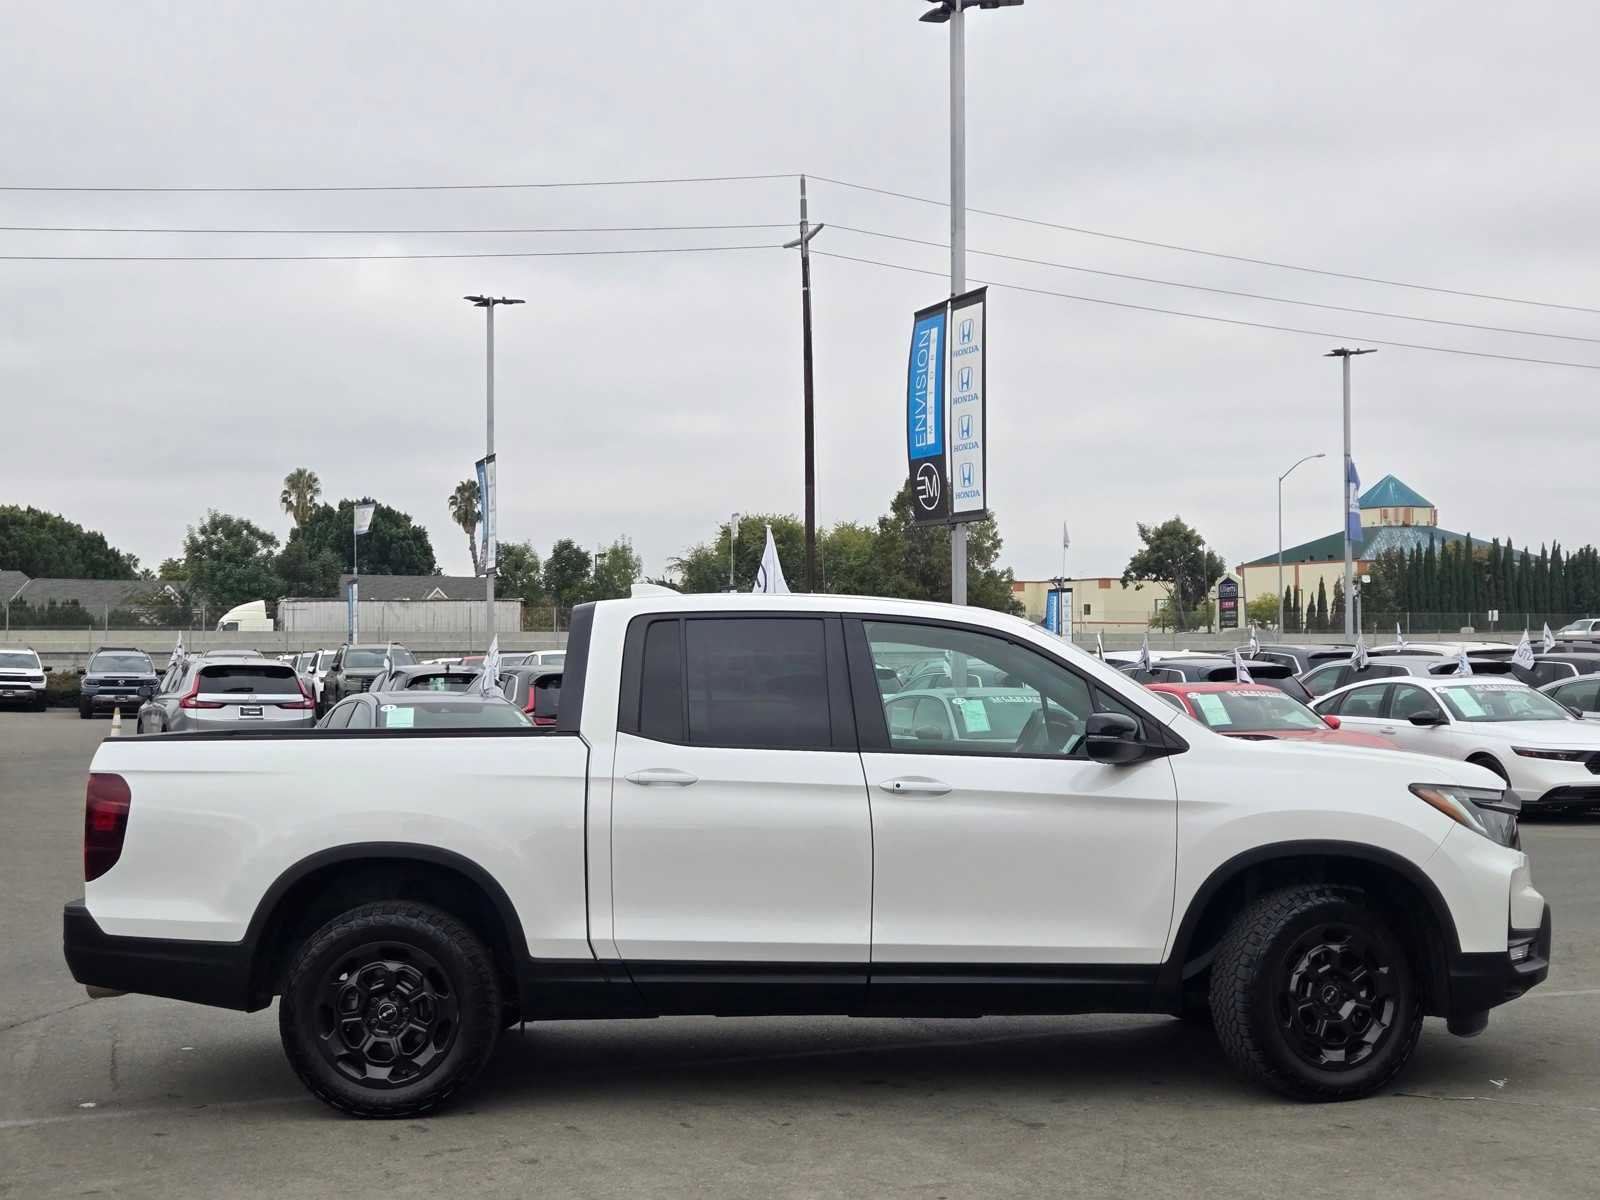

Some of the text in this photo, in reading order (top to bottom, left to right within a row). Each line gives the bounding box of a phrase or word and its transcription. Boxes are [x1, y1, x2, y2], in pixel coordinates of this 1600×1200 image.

[953, 345, 980, 358] HONDA
[915, 329, 930, 447] ENVISION
[953, 393, 979, 405] HONDA
[953, 441, 980, 453] HONDA
[955, 489, 981, 501] HONDA
